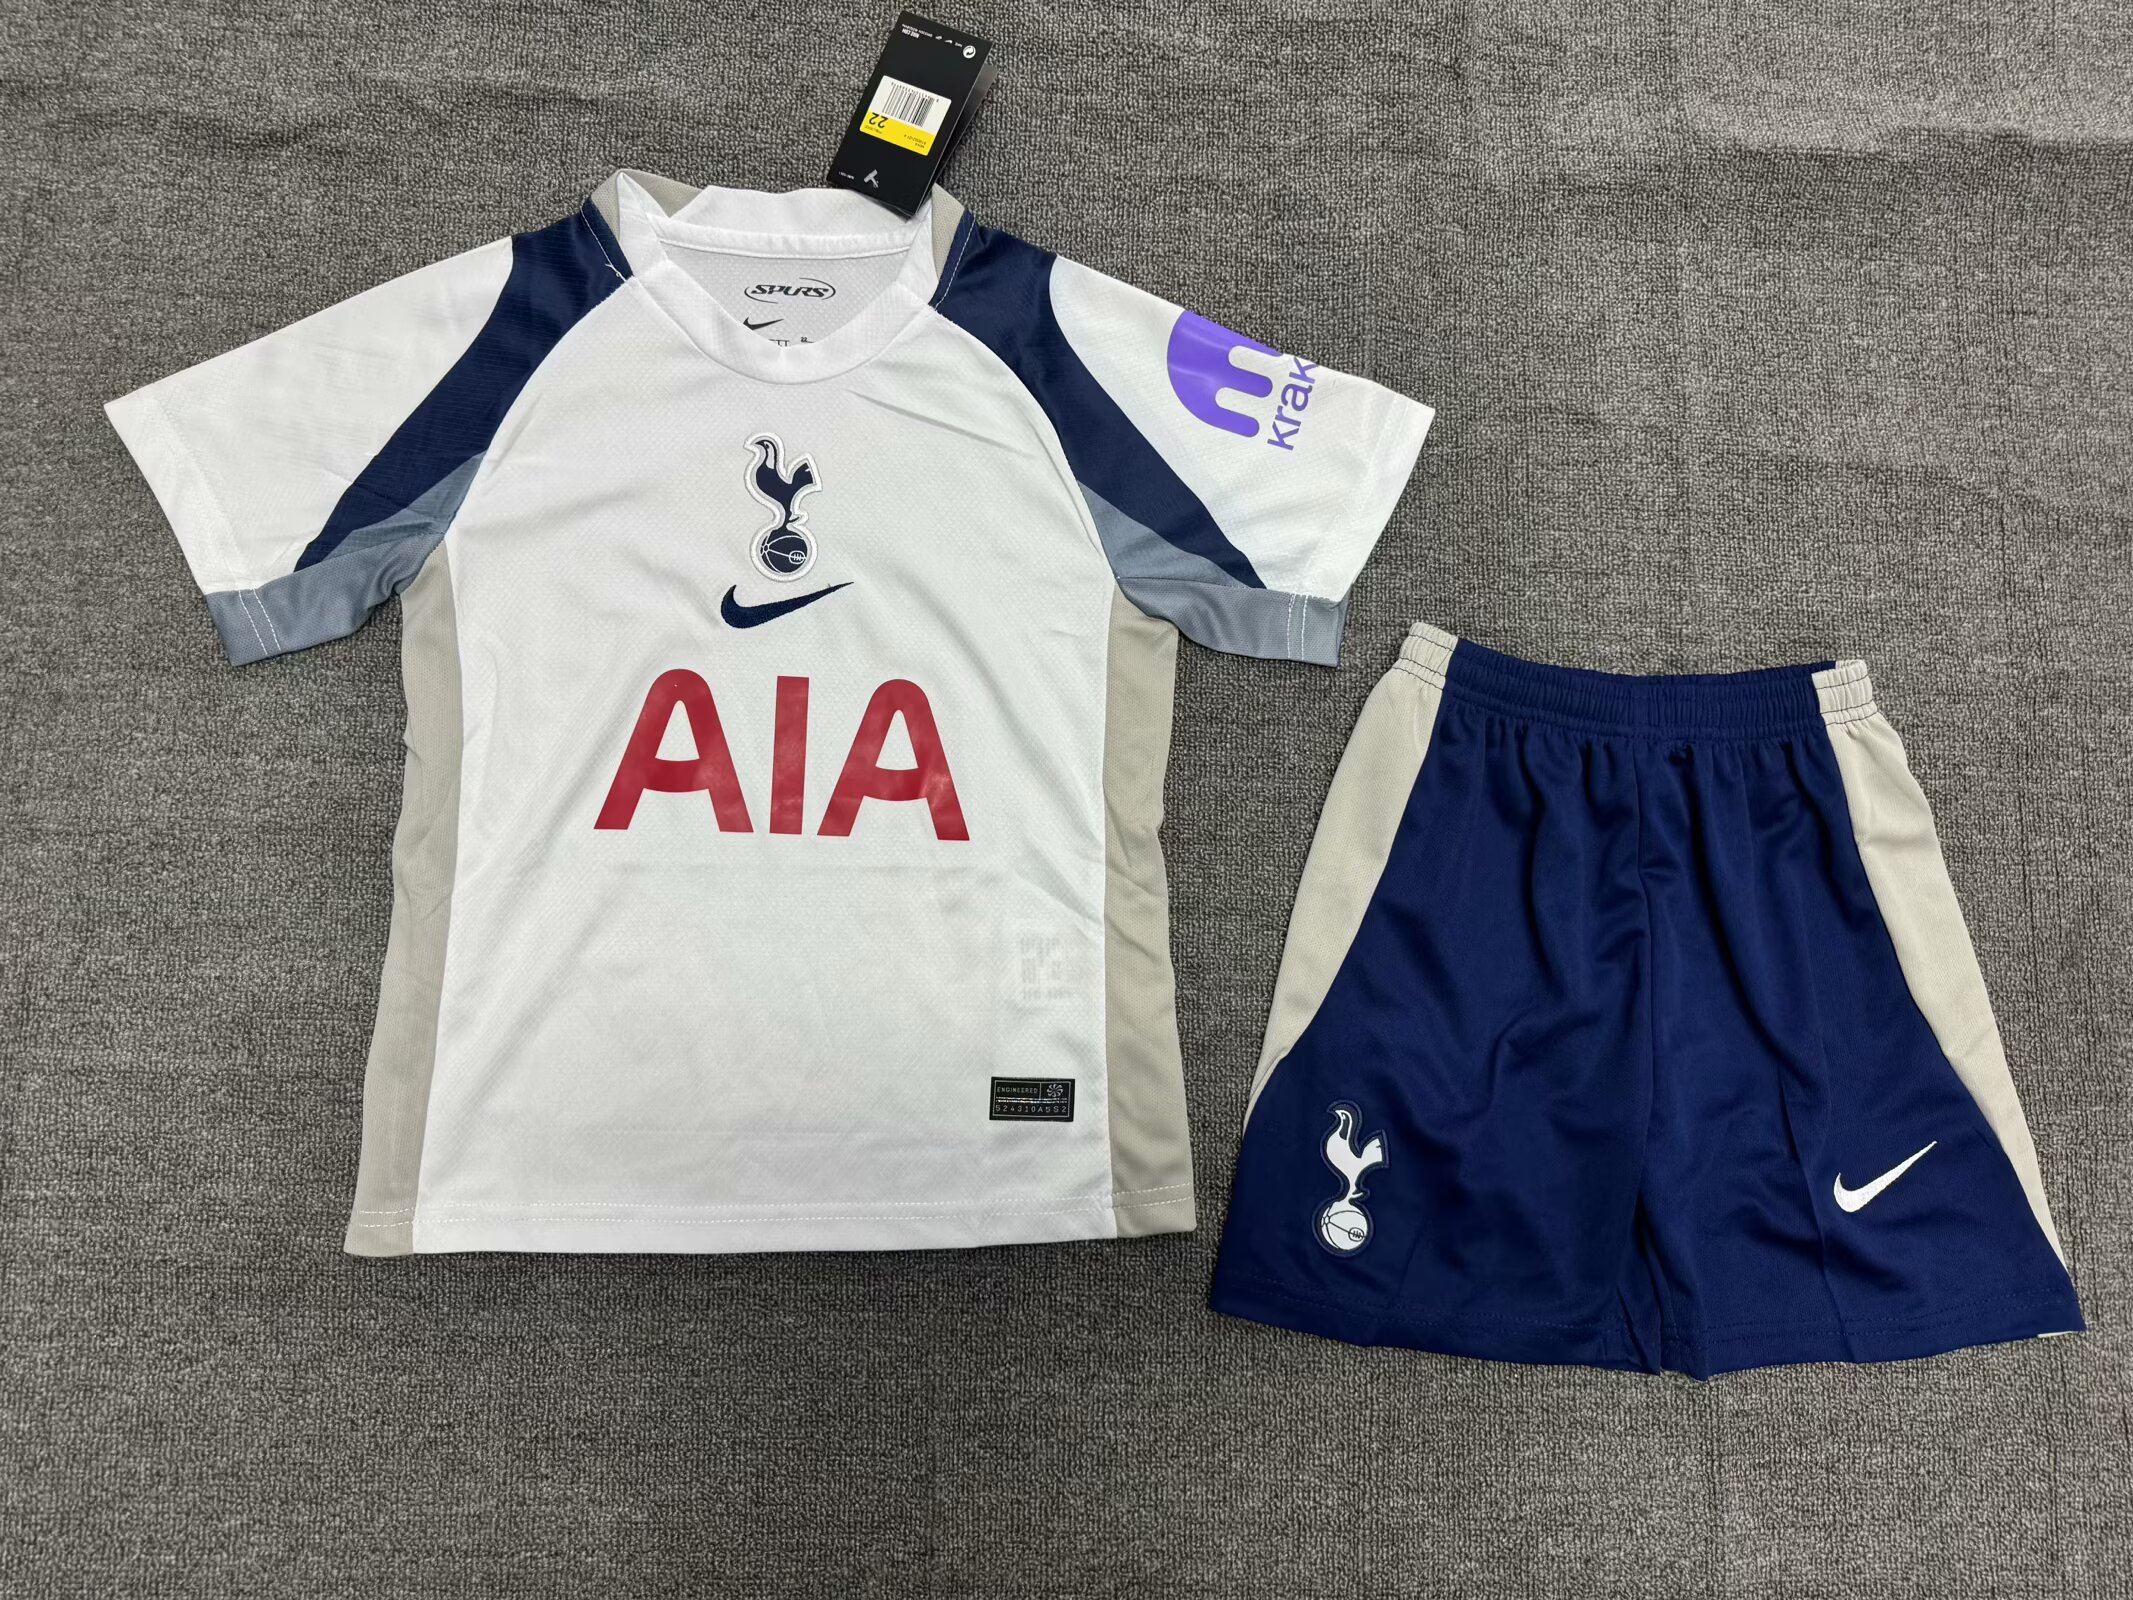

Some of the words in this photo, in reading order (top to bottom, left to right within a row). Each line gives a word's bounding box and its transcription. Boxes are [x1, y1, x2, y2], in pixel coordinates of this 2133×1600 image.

[869, 112, 888, 129] 22
[751, 284, 828, 298] SPURS
[593, 668, 970, 841] AIA
[997, 1086, 1038, 1094] ENGINEERED
